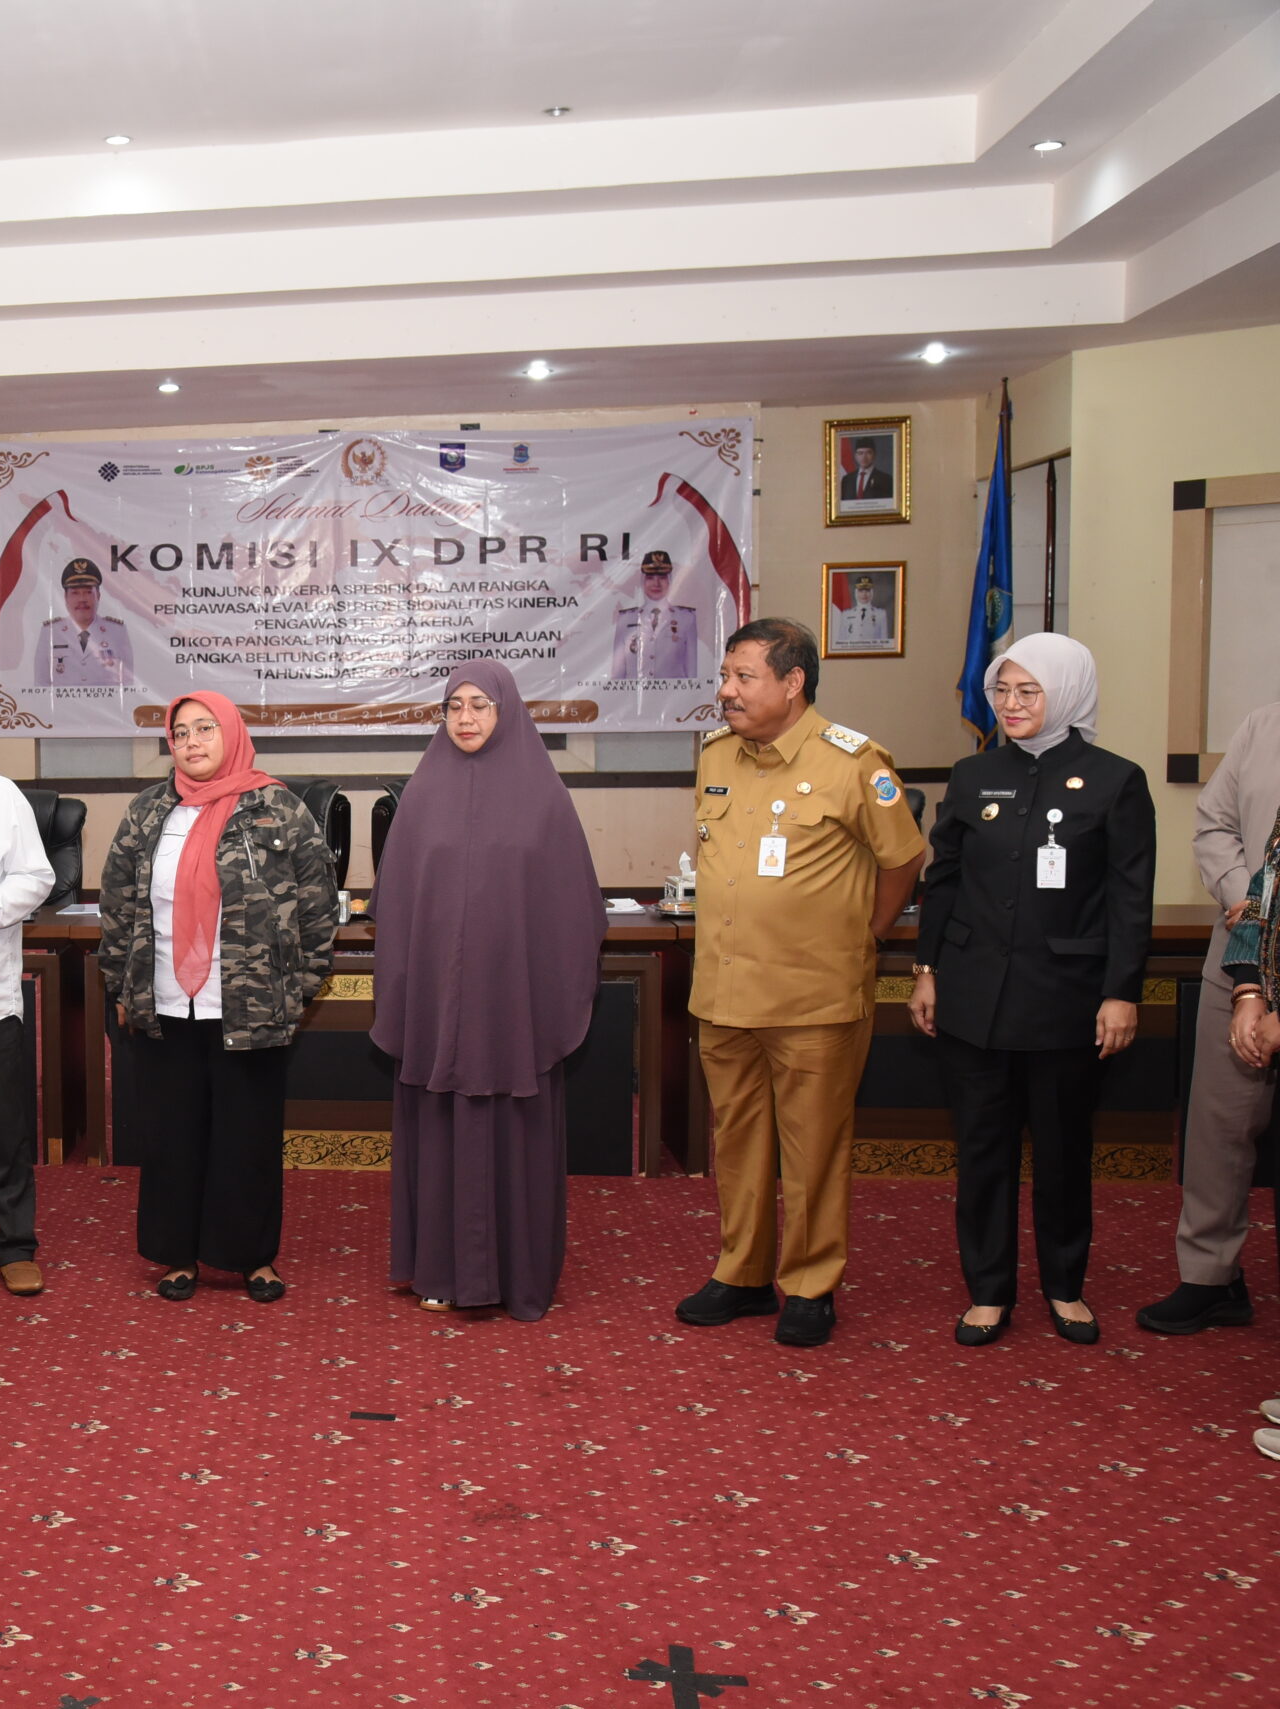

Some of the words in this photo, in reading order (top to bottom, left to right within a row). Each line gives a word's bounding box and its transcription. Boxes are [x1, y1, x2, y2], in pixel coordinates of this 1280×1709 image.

[236, 493, 357, 523] Selamat
[360, 490, 482, 526] Datang
[110, 540, 318, 572] KOMISI
[350, 538, 402, 567] IX
[433, 535, 548, 566] DPR
[580, 532, 630, 562] RI
[181, 585, 287, 598] KUNJUNGAN
[288, 584, 341, 597] KERJA
[343, 582, 412, 596] SPESIFIK
[419, 581, 475, 595] DALAM
[478, 580, 550, 593] RANGKA
[153, 602, 269, 615] PENGAWASAN
[272, 601, 351, 613] EVALUASI
[507, 596, 579, 609] KINERJA
[254, 618, 347, 630] PENGAWAS
[351, 616, 417, 629] TENAGA
[420, 615, 474, 627] KERJA
[170, 636, 185, 647] DI
[188, 636, 232, 647] KOTA
[235, 634, 313, 647] PANGKAL
[315, 633, 379, 646] PINANG
[380, 631, 458, 645] PROVINSI
[460, 630, 562, 644] KEPULAUAN
[175, 653, 243, 664] BANGKA
[245, 651, 326, 664] BELITUNG
[424, 647, 545, 661] PERSIDANGAN
[547, 647, 557, 659] II
[254, 668, 313, 680] TAHUN
[314, 667, 379, 680] SIDANG
[429, 665, 459, 678] 20
[607, 679, 671, 687] AYUTRSNA,
[260, 710, 347, 721] PINANG,
[362, 710, 384, 719] 24
[529, 706, 579, 718] 2025
